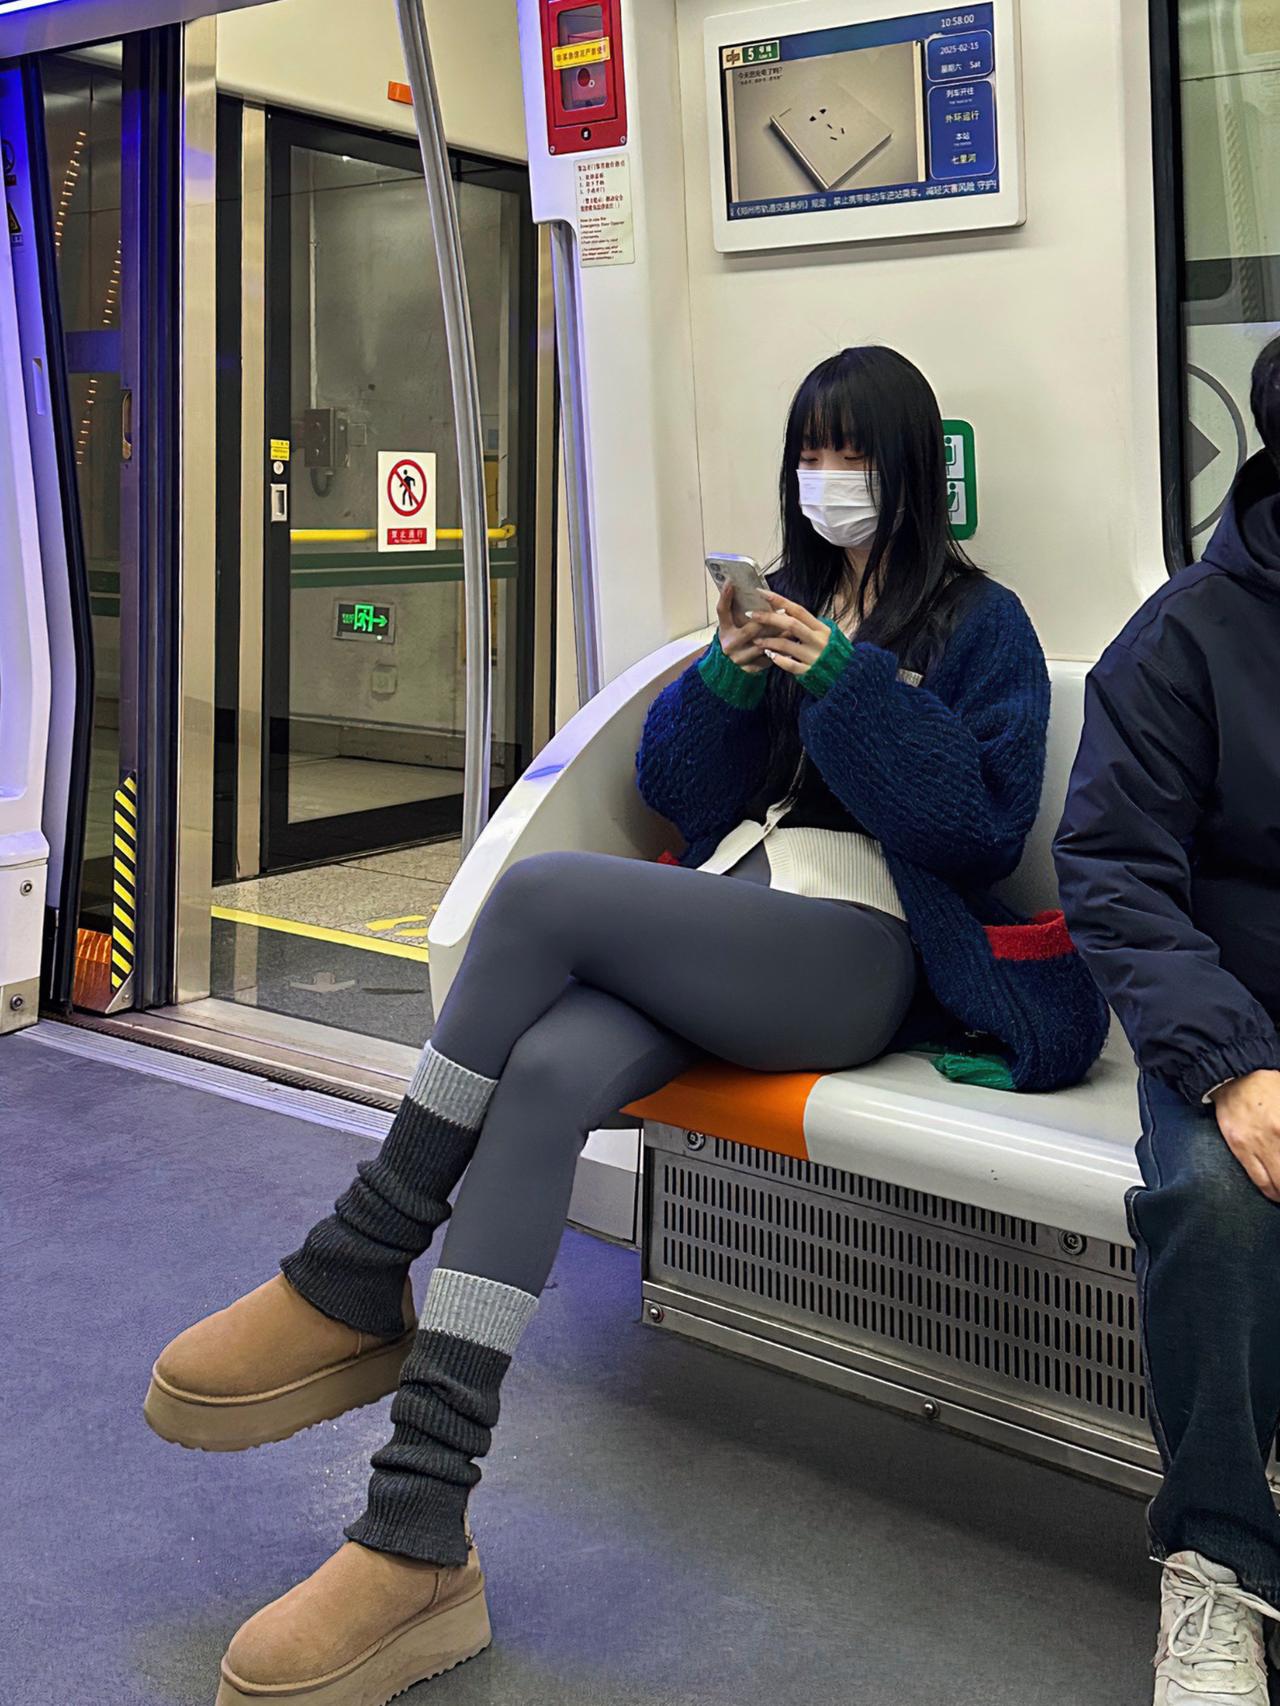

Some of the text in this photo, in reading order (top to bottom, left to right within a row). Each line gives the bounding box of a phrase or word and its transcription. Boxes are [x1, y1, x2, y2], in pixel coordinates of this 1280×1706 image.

[747, 47, 754, 61] 5
[940, 41, 979, 55] 2025-02-15
[941, 60, 981, 74] 星期六 Sat
[946, 87, 974, 98] 列车开往
[945, 110, 980, 123] 外环运行
[956, 131, 970, 141] 本站
[951, 153, 977, 165] 七里河
[391, 529, 423, 539] 禁止通行
